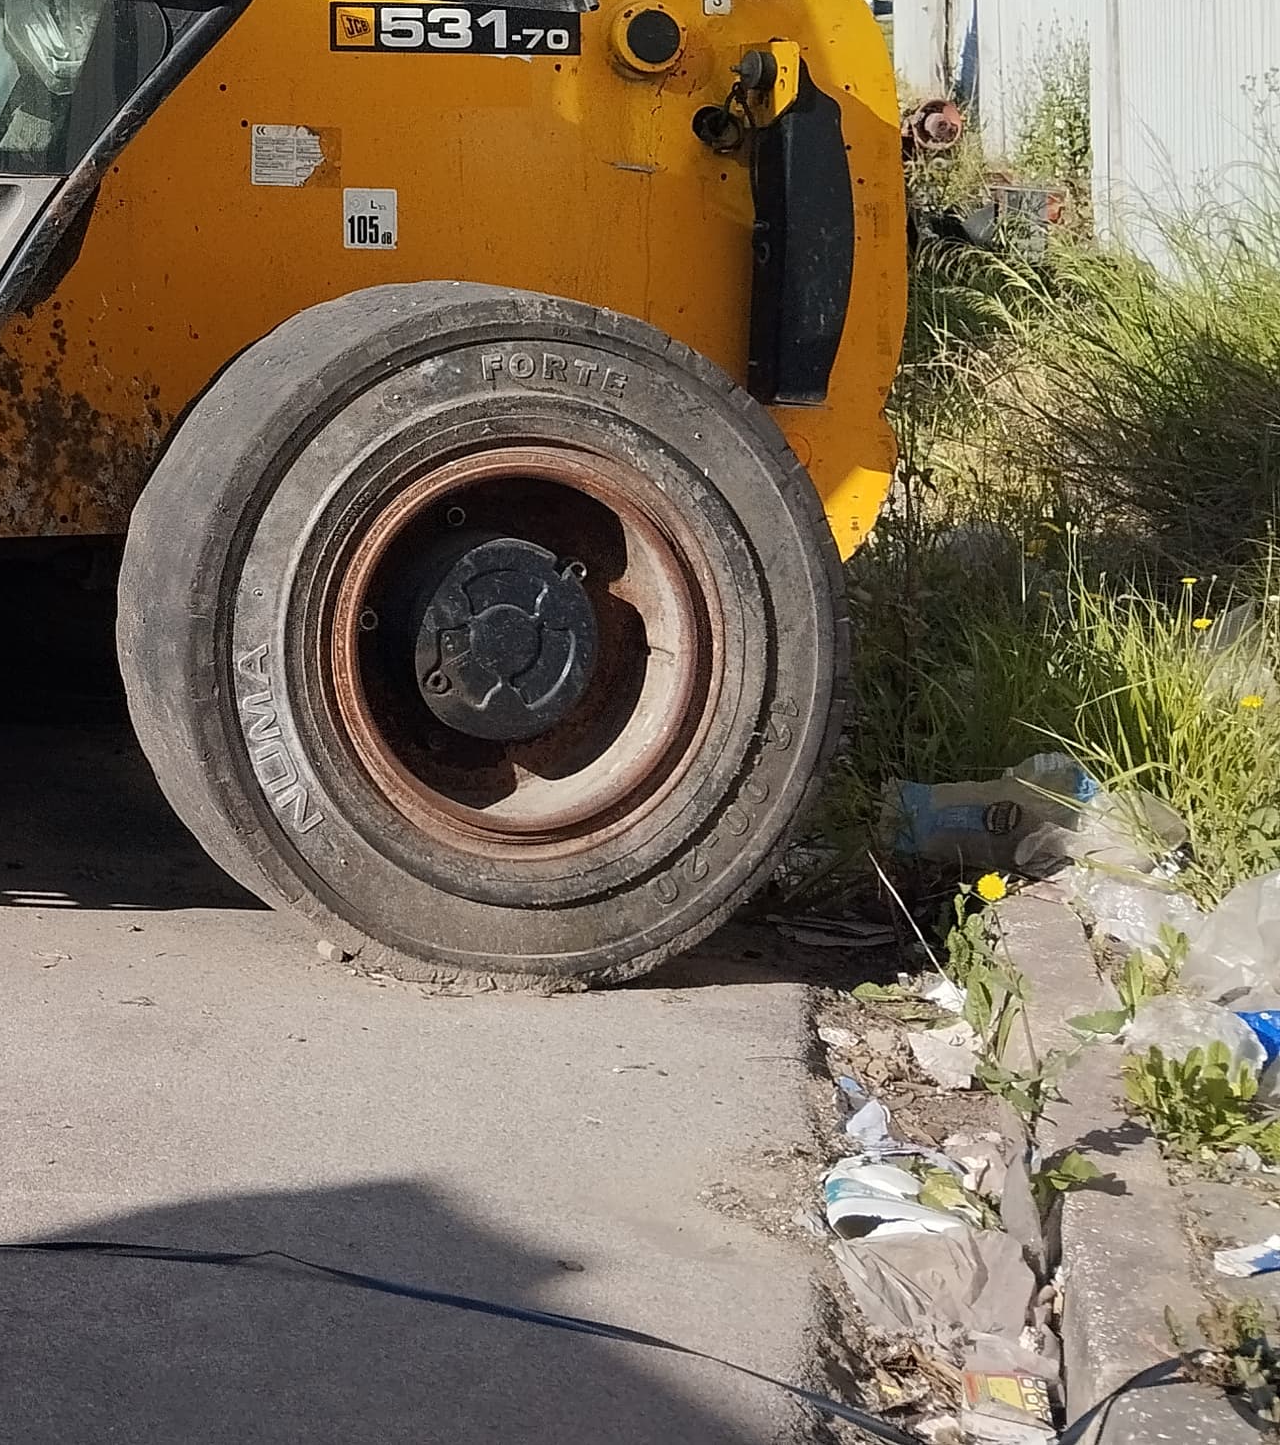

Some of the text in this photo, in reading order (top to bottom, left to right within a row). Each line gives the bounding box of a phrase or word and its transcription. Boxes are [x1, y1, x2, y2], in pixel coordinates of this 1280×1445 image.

[345, 16, 370, 36] JCB
[348, 214, 379, 244] 105
[481, 352, 629, 399] FORTE
[238, 643, 325, 835] NUMA
